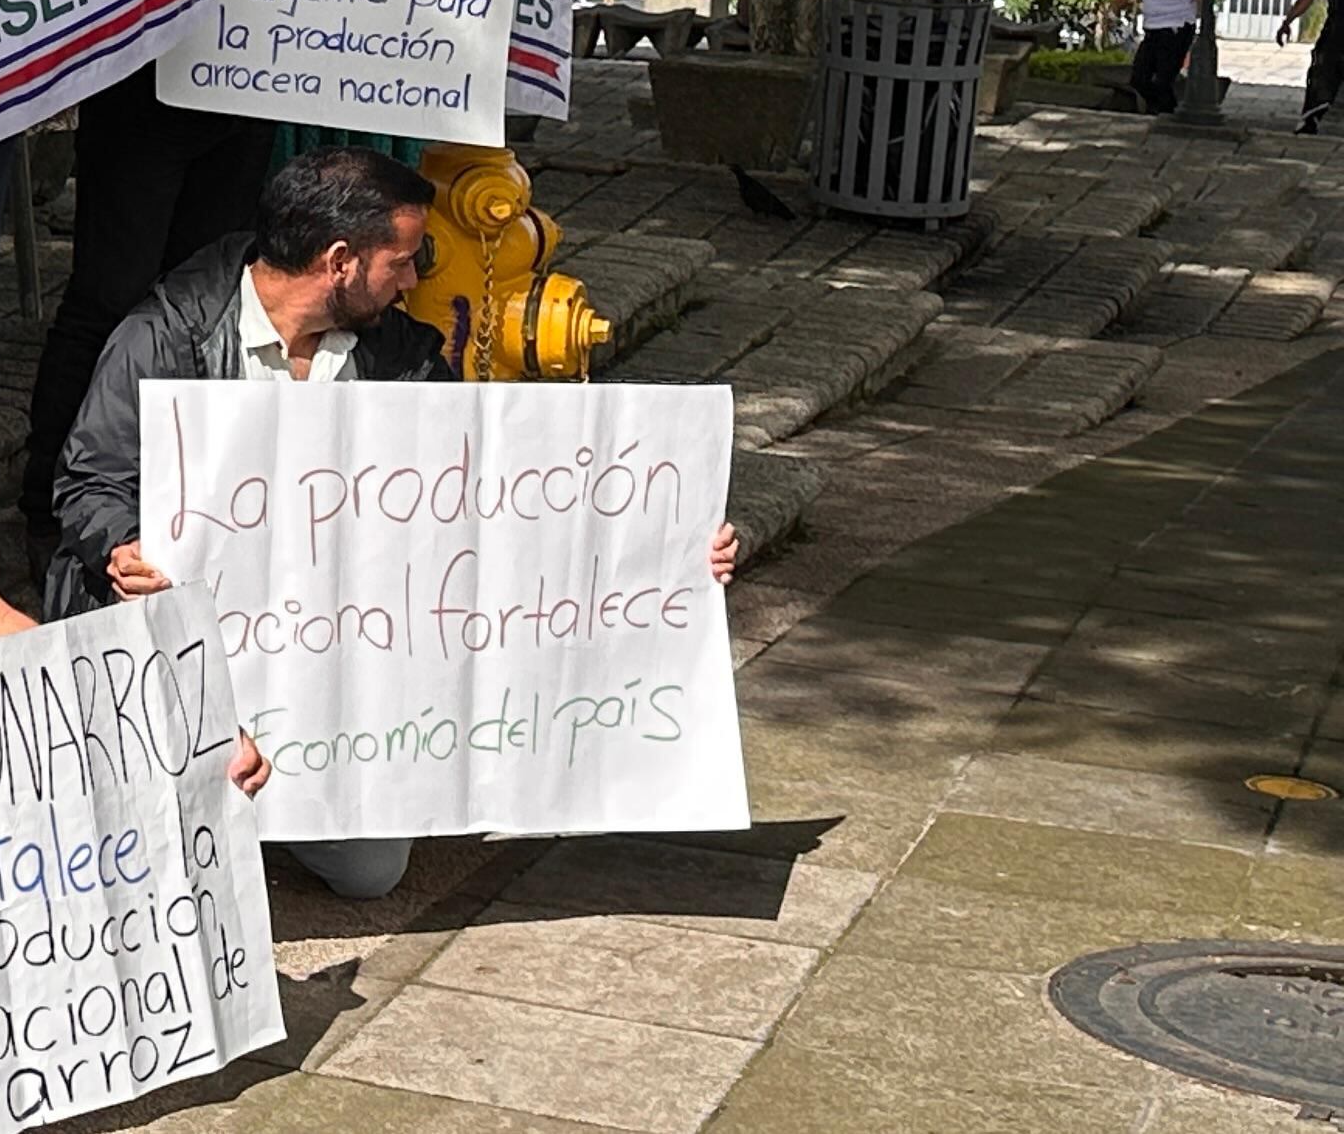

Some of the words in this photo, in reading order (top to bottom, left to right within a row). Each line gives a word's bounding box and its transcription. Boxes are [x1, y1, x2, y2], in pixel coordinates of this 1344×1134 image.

[217, 4, 249, 50] la
[267, 16, 455, 66] producción
[191, 59, 322, 96] arrocera
[339, 72, 472, 113] nacional
[170, 395, 269, 544] La
[298, 431, 683, 565] producción
[212, 562, 414, 658] acional
[429, 549, 694, 661] fortalece
[249, 706, 458, 776] Economía
[468, 688, 540, 756] del
[553, 677, 684, 768] país
[176, 792, 219, 879] la
[213, 923, 249, 1002] de
[7, 1022, 216, 1123] arroz
